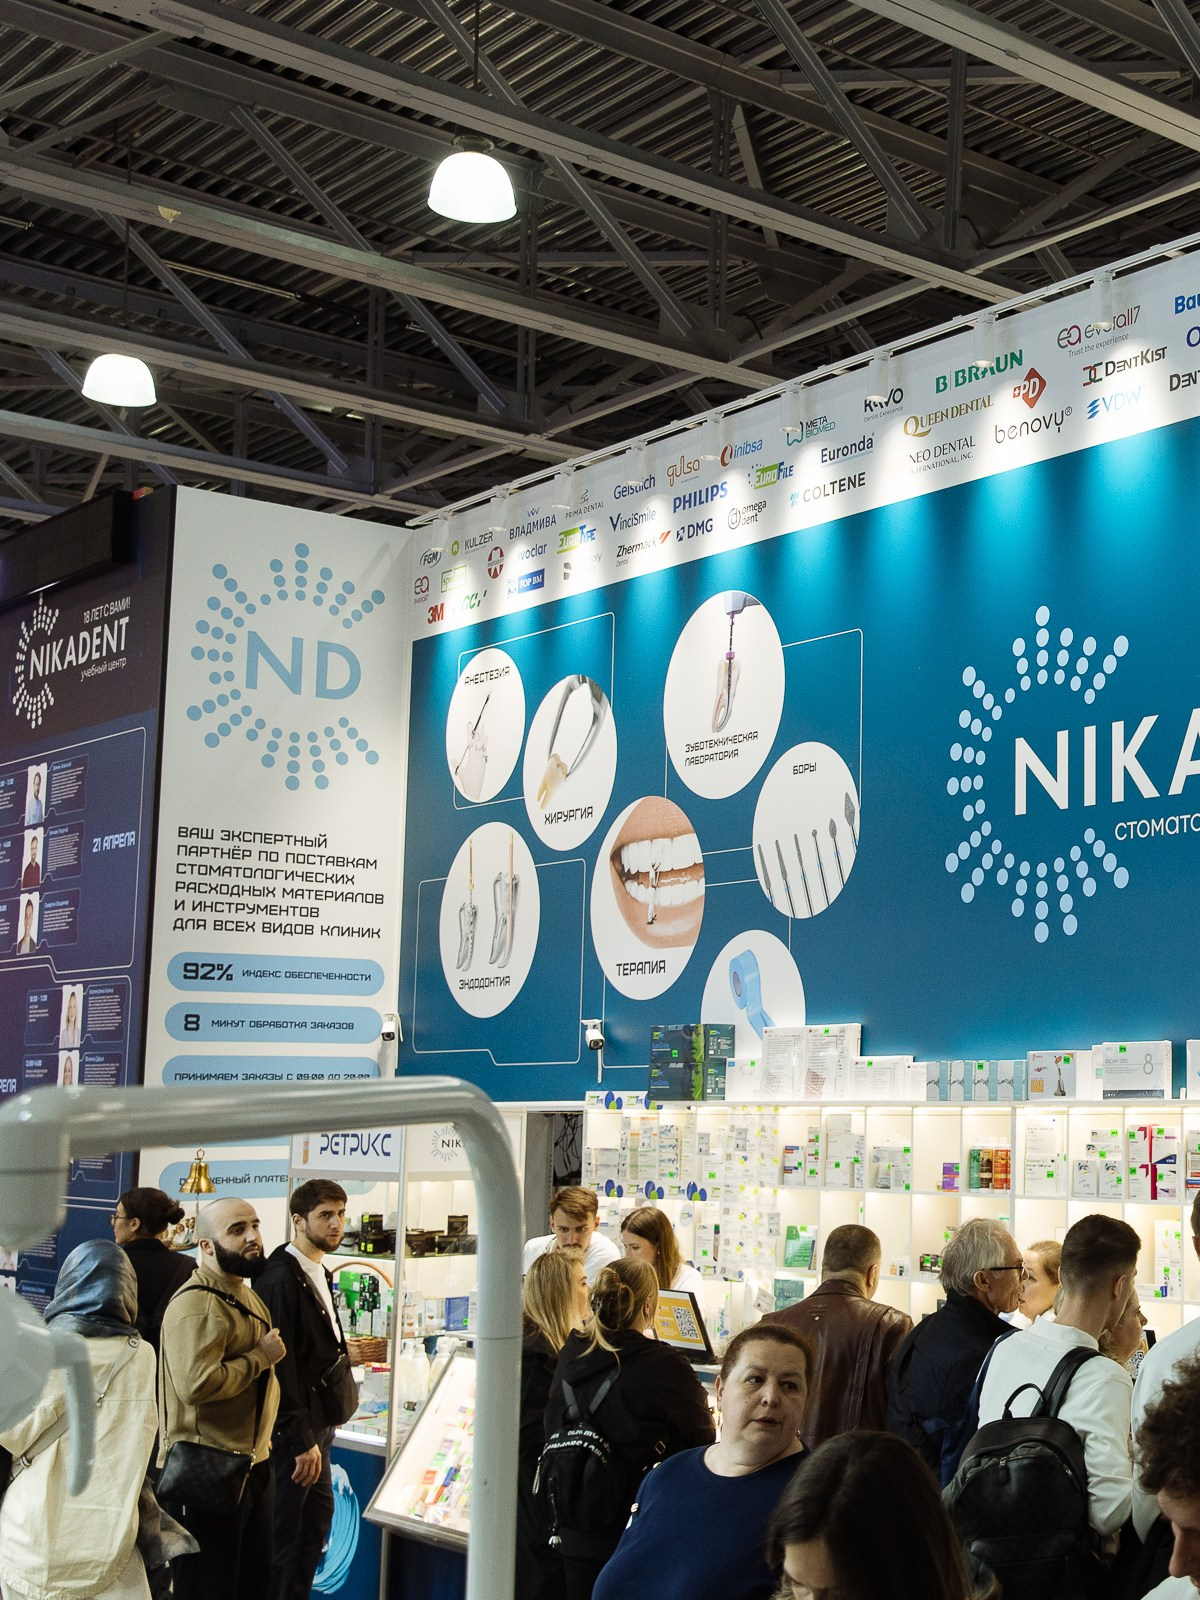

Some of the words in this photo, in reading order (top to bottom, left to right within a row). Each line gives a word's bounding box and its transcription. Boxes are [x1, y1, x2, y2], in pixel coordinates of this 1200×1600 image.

[1084, 344, 1095, 353] the
[1095, 332, 1129, 349] experience
[954, 349, 1023, 388] BRAUN
[806, 415, 828, 430] META
[903, 409, 949, 438] QUEEN
[950, 394, 994, 420] DENTAL
[806, 421, 836, 438] BIOMED
[734, 439, 763, 459] inibsa
[821, 435, 874, 463] Euronda
[910, 448, 931, 464] NEO
[934, 435, 976, 458] DENTAL
[673, 481, 728, 513] PHILIPS
[803, 472, 866, 503] COLTENE
[565, 508, 582, 520] PRIMA
[583, 501, 605, 514] DENTAL
[741, 500, 767, 515] omega
[509, 514, 557, 540] ВЛАДМИВА
[609, 508, 656, 532] VinciSmile
[687, 518, 713, 539] DMG
[464, 531, 494, 550] KULZER
[616, 536, 657, 558] Zhermack
[423, 551, 439, 566] FGM
[519, 576, 532, 589] TOP
[532, 573, 544, 586] BM
[83, 610, 92, 625] 18
[92, 605, 105, 622] ЛЕТ
[110, 596, 131, 617] ВАМИ!
[427, 602, 445, 624] 3M
[29, 616, 130, 680] NIKADENT
[81, 661, 106, 682] учебный
[106, 657, 127, 677] центр
[245, 630, 362, 700] ND
[464, 666, 510, 686] АНЕСТЕЗИЯ
[684, 730, 759, 753] ЗУБОТЕХНИЧЕСКАЯ
[684, 749, 739, 767] ЛАБОРАТОРИЯ
[793, 761, 817, 775] БОРЫ
[544, 806, 594, 825] ХИРУРГИЯ
[92, 837, 101, 853] 21
[102, 831, 136, 851] АПРЕЛЯ
[178, 826, 214, 840] ВАШ
[220, 829, 328, 848] ЭКСПЕРТНЫЙ
[176, 844, 252, 860] ПАРТНЁР
[258, 850, 279, 863] ПО
[285, 852, 378, 869] ПОСТАВКАМ
[176, 862, 355, 885] СТОМАТОЛОГИЧЕСКИХ
[175, 881, 276, 898] РАСХОДНЫХ
[282, 887, 384, 905] МАТЕРИАЛОВ
[174, 899, 185, 911] И
[192, 900, 320, 918] ИНСТРУМЕНТОВ
[173, 918, 207, 931] ДЛЯ
[213, 919, 256, 933] ВСЕХ
[262, 922, 314, 936] ВИДОВ
[320, 925, 381, 939] КЛИНИК
[182, 962, 234, 982] 92%
[242, 968, 282, 980] ИНДЕКС
[284, 970, 372, 983] ОБЕСПЕЧЕННОСТИ
[616, 959, 666, 976] ТЕРАПИЯ
[458, 974, 511, 991] ЭНДОДОНТИЯ
[183, 1013, 201, 1032] 8
[211, 1018, 246, 1029] МИНУТ
[248, 1019, 308, 1030] ОБРАБОТКА
[310, 1020, 355, 1030] ЗАКАЗОВ
[174, 1072, 239, 1081] ПРИНИМАЕМ
[242, 1073, 284, 1081] ЗАКАЗЫ
[286, 1073, 293, 1081] С
[296, 1073, 325, 1081] 09:00
